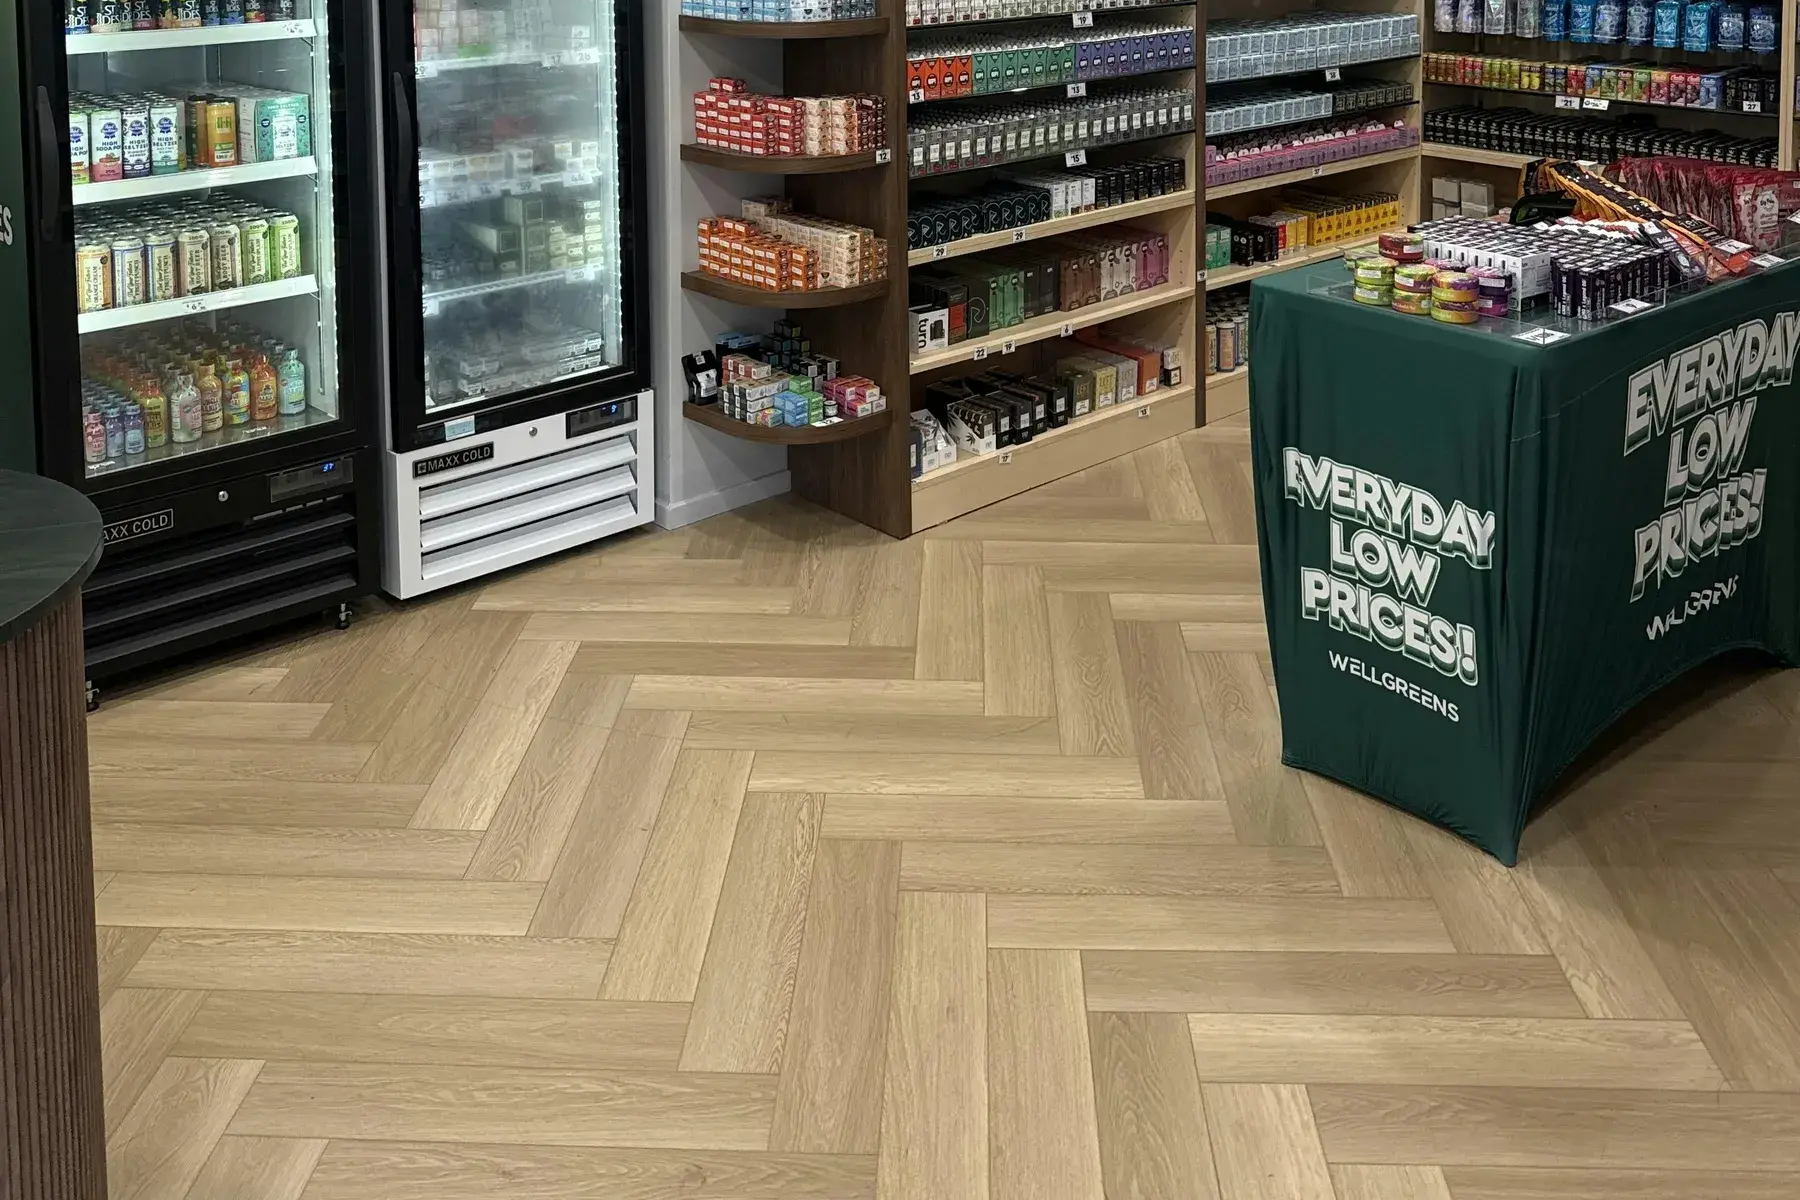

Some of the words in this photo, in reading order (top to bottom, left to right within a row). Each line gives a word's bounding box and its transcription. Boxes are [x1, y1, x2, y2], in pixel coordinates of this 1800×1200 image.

[918, 318, 929, 349] turn
[1624, 312, 1800, 457] EVERYDAY
[428, 453, 460, 472] MAXX
[462, 448, 491, 464] COLD
[1664, 396, 1757, 508] LOW
[133, 514, 169, 533] COLD
[1283, 447, 1496, 570] EVERYDAY
[1629, 467, 1768, 603] PRICES!
[1330, 516, 1441, 607] LOW
[1301, 566, 1478, 686] PRICES!
[1329, 650, 1460, 723] WELLGREENS
